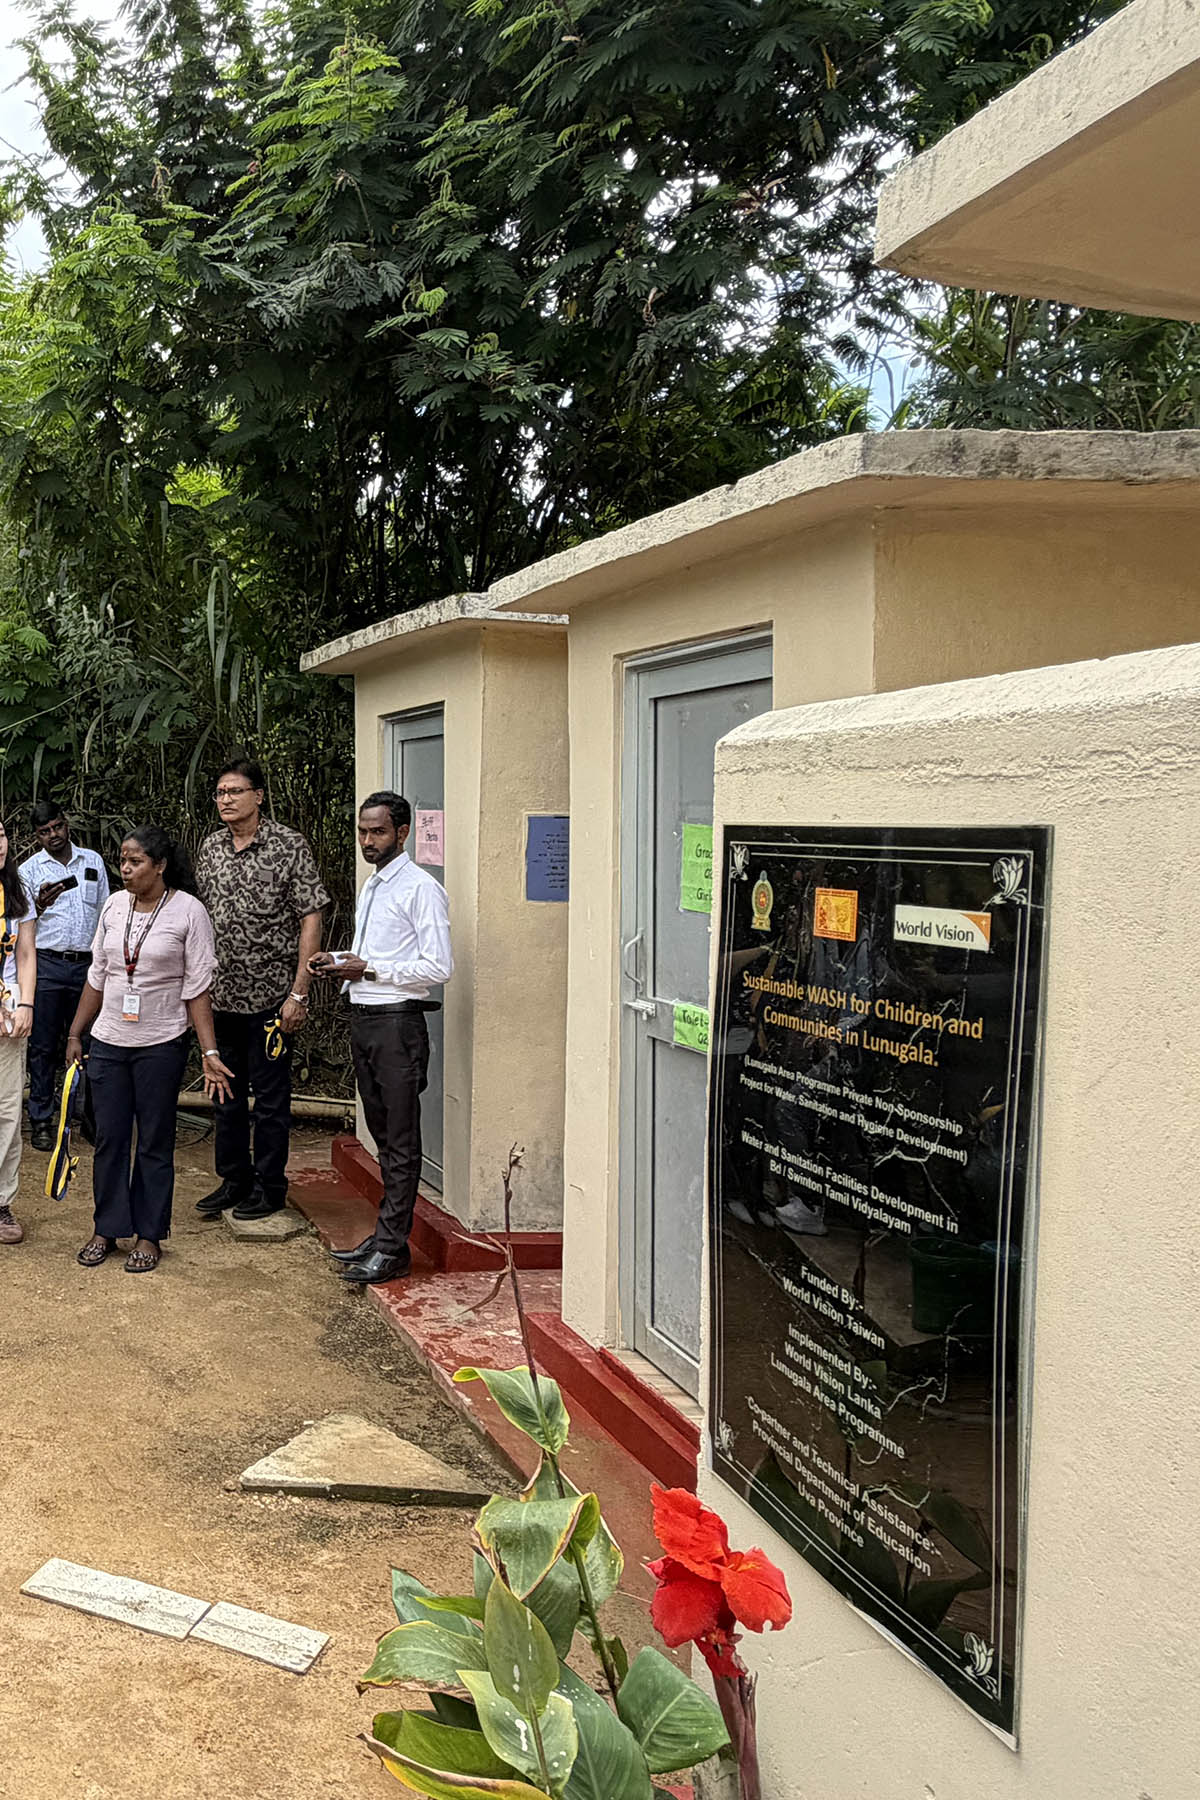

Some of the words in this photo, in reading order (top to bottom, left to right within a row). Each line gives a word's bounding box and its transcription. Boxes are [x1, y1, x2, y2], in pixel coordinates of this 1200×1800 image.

[896, 920, 932, 938] World
[935, 924, 975, 943] Vision
[742, 970, 805, 1000] Sustainable
[807, 986, 847, 1010] WASH
[850, 993, 872, 1015] for
[875, 999, 944, 1031] Children
[948, 1017, 983, 1039] and
[763, 1005, 842, 1044] Communities
[846, 1028, 859, 1046] in
[862, 1030, 939, 1067] Lunugala.
[740, 1074, 763, 1091] Project
[764, 1081, 775, 1094] for
[775, 1087, 799, 1104] Water,
[799, 1096, 838, 1118] Sanitation
[839, 1110, 856, 1125] and
[857, 1113, 895, 1138] Hygiene
[896, 1128, 968, 1166] Development)
[744, 1055, 777, 1076] (Lunugala
[778, 1062, 795, 1081] Area
[796, 1072, 841, 1096] Programme
[842, 1087, 873, 1106] Private
[875, 1096, 964, 1136] Non-Sponsorship
[741, 1130, 763, 1150] Water
[764, 1142, 780, 1156] and
[781, 1146, 824, 1177] Sanitation
[826, 1167, 869, 1195] Facilities
[871, 1186, 944, 1229] Development
[947, 1217, 959, 1235] in
[770, 1159, 782, 1175] Bd
[787, 1168, 823, 1195] Swinton
[825, 1184, 850, 1206] Tamil
[851, 1196, 912, 1234] Vidyalayam
[782, 1276, 811, 1305] World
[812, 1293, 844, 1325] Vision
[846, 1313, 886, 1350] Taiwan
[801, 1266, 839, 1299] Funded
[841, 1288, 864, 1312] By:-
[784, 1341, 812, 1373] World
[814, 1362, 845, 1395] Vision
[847, 1385, 883, 1420] Lanka
[788, 1323, 851, 1376] Implemented
[853, 1364, 878, 1391] By:-
[770, 1352, 812, 1394] Lunugala
[813, 1384, 837, 1411] Area
[838, 1402, 906, 1460] Programme
[746, 1396, 792, 1441] Co-partner
[792, 1434, 810, 1457] and
[811, 1448, 860, 1498] Technical
[861, 1491, 942, 1556] Assistance:-
[752, 1419, 793, 1466] Provincial
[794, 1455, 852, 1516] Department
[853, 1507, 866, 1525] of
[867, 1516, 932, 1576] Education
[798, 1481, 816, 1507] Uva
[817, 1502, 865, 1548] Province
